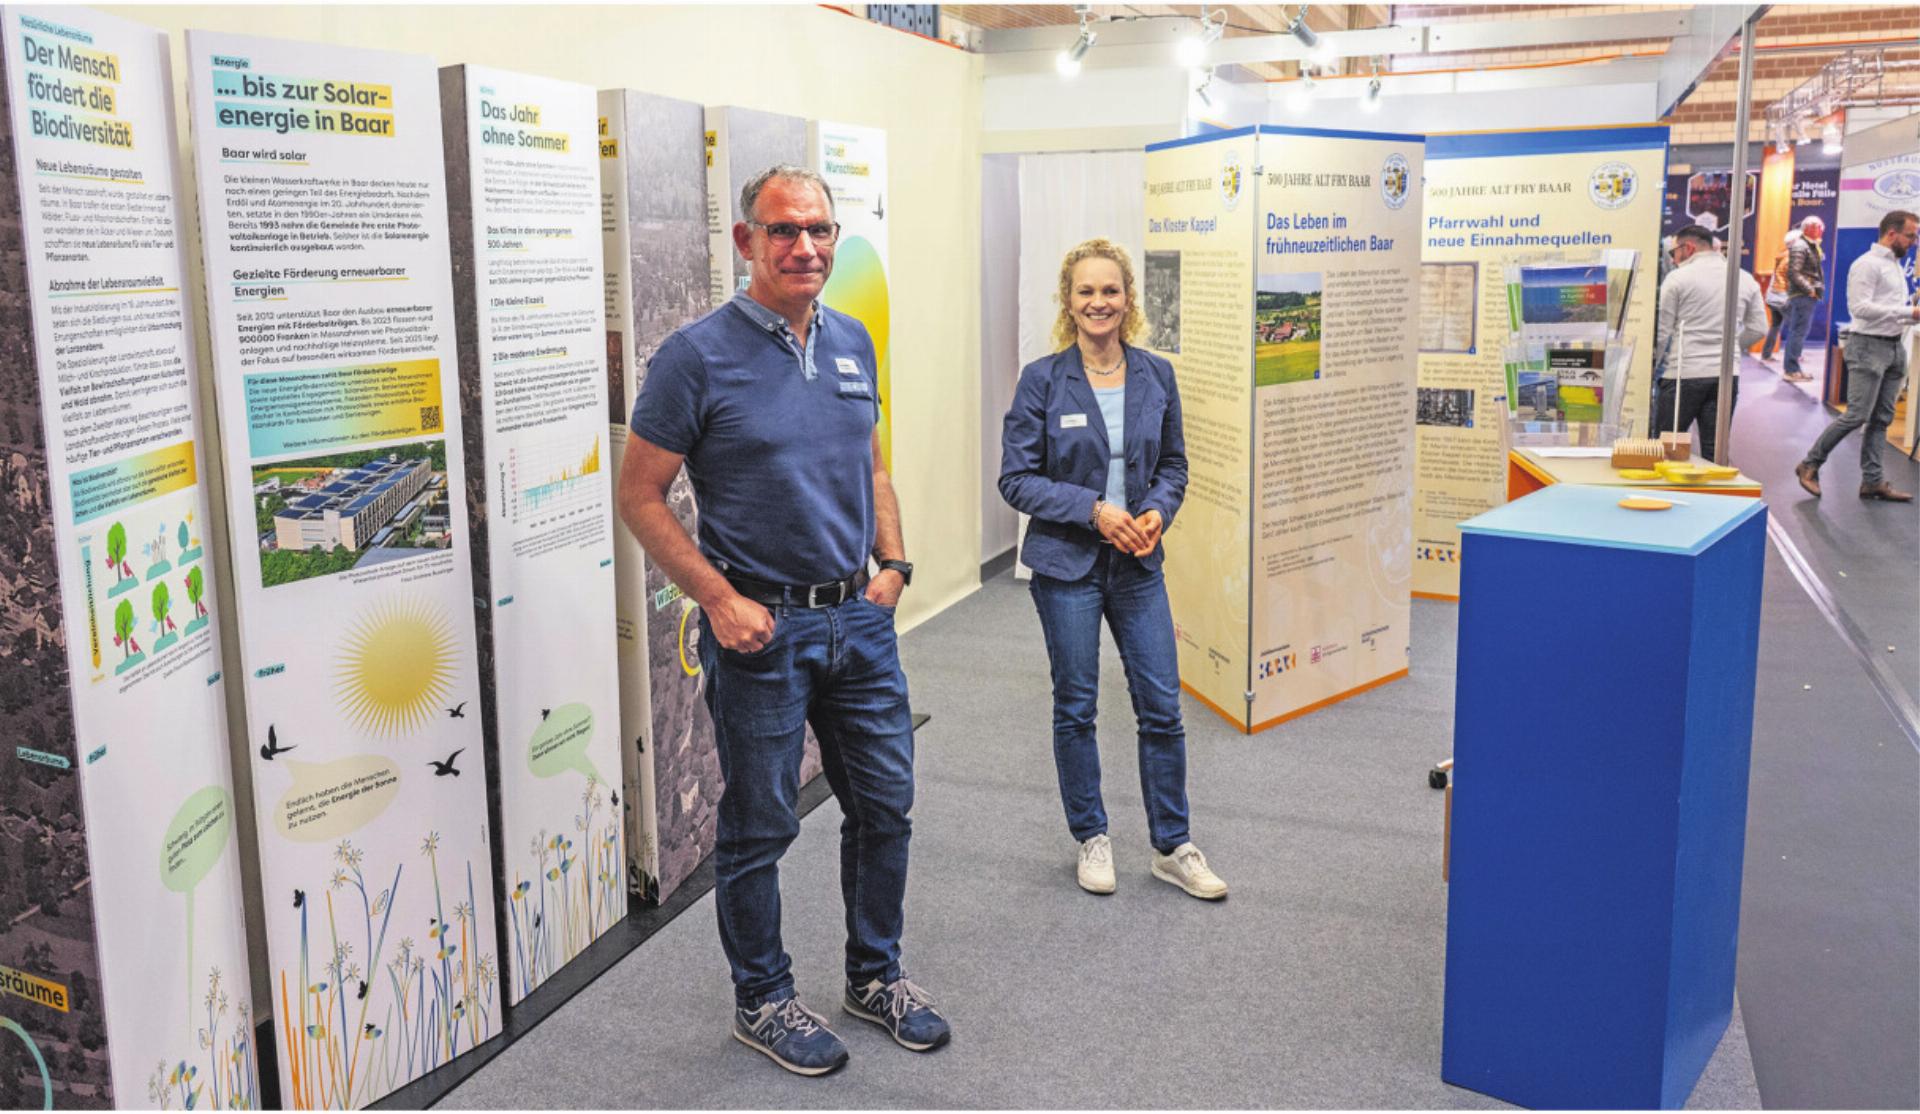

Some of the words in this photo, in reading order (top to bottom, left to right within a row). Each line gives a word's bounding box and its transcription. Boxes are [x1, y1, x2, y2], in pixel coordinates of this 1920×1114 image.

[24, 36, 54, 66] Der
[58, 45, 116, 80] Mensch
[214, 57, 249, 70] Energie
[28, 72, 86, 107] fördert
[89, 86, 112, 112] die
[242, 75, 276, 98] bis
[283, 83, 318, 101] zur
[323, 82, 388, 105] Solar-
[481, 100, 506, 120] Das
[510, 105, 539, 124] Jahr
[219, 108, 310, 134] energie
[315, 110, 334, 130] in
[341, 113, 390, 134] Baar
[32, 110, 132, 148] Biodiversität
[482, 126, 515, 145] ohne
[518, 131, 566, 150] Sommer
[222, 147, 250, 159] Baar
[252, 149, 277, 160] wird
[279, 151, 307, 161] solar
[36, 158, 57, 172] Neue
[59, 161, 108, 176] Lebensräume
[110, 168, 143, 180] gestalten
[224, 175, 239, 183] Die
[241, 176, 270, 184] kleinen
[1267, 173, 1282, 185] 500
[1283, 173, 1312, 187] JAHRE
[1315, 174, 1330, 186] ALT
[1331, 174, 1348, 187] FRY
[1349, 175, 1371, 187] BAAR
[1802, 181, 1828, 190] Hotel
[1450, 186, 1487, 198] JAHRE
[1491, 186, 1512, 196] ALT
[1514, 184, 1537, 195] FRY
[1539, 183, 1571, 193] BAAR
[228, 221, 257, 229] Bereits
[260, 221, 279, 229] 1993
[1149, 218, 1161, 232] Das
[1163, 217, 1188, 232] Kloster
[1190, 216, 1217, 236] Kappel
[1267, 212, 1290, 230] Das
[1294, 212, 1329, 230] Leben
[1333, 213, 1347, 229] im
[1429, 215, 1503, 229] Pfarrwahl
[1510, 214, 1540, 228] und
[487, 226, 498, 234] Das
[500, 226, 517, 235] Klima
[1266, 236, 1366, 254] frühneuzeitlichen
[1370, 235, 1394, 251] Baar
[1428, 236, 1464, 247] neue
[1471, 231, 1612, 248] Einnahmequellen
[233, 269, 280, 280] Gezielte
[283, 268, 339, 280] Förderung
[340, 266, 406, 277] erneuerbarer
[49, 280, 85, 291] Abnahme
[87, 278, 100, 289] der
[234, 285, 285, 299] Energien
[255, 312, 274, 320] 2012
[238, 324, 275, 334] Energien
[277, 333, 310, 341] Franken
[259, 663, 285, 677] früher
[286, 794, 314, 809] Endlich
[315, 786, 340, 799] haben
[341, 782, 353, 791] die
[353, 768, 390, 785] Menschen
[331, 788, 361, 803] Energie
[361, 785, 374, 793] der
[375, 776, 397, 789] Sonne
